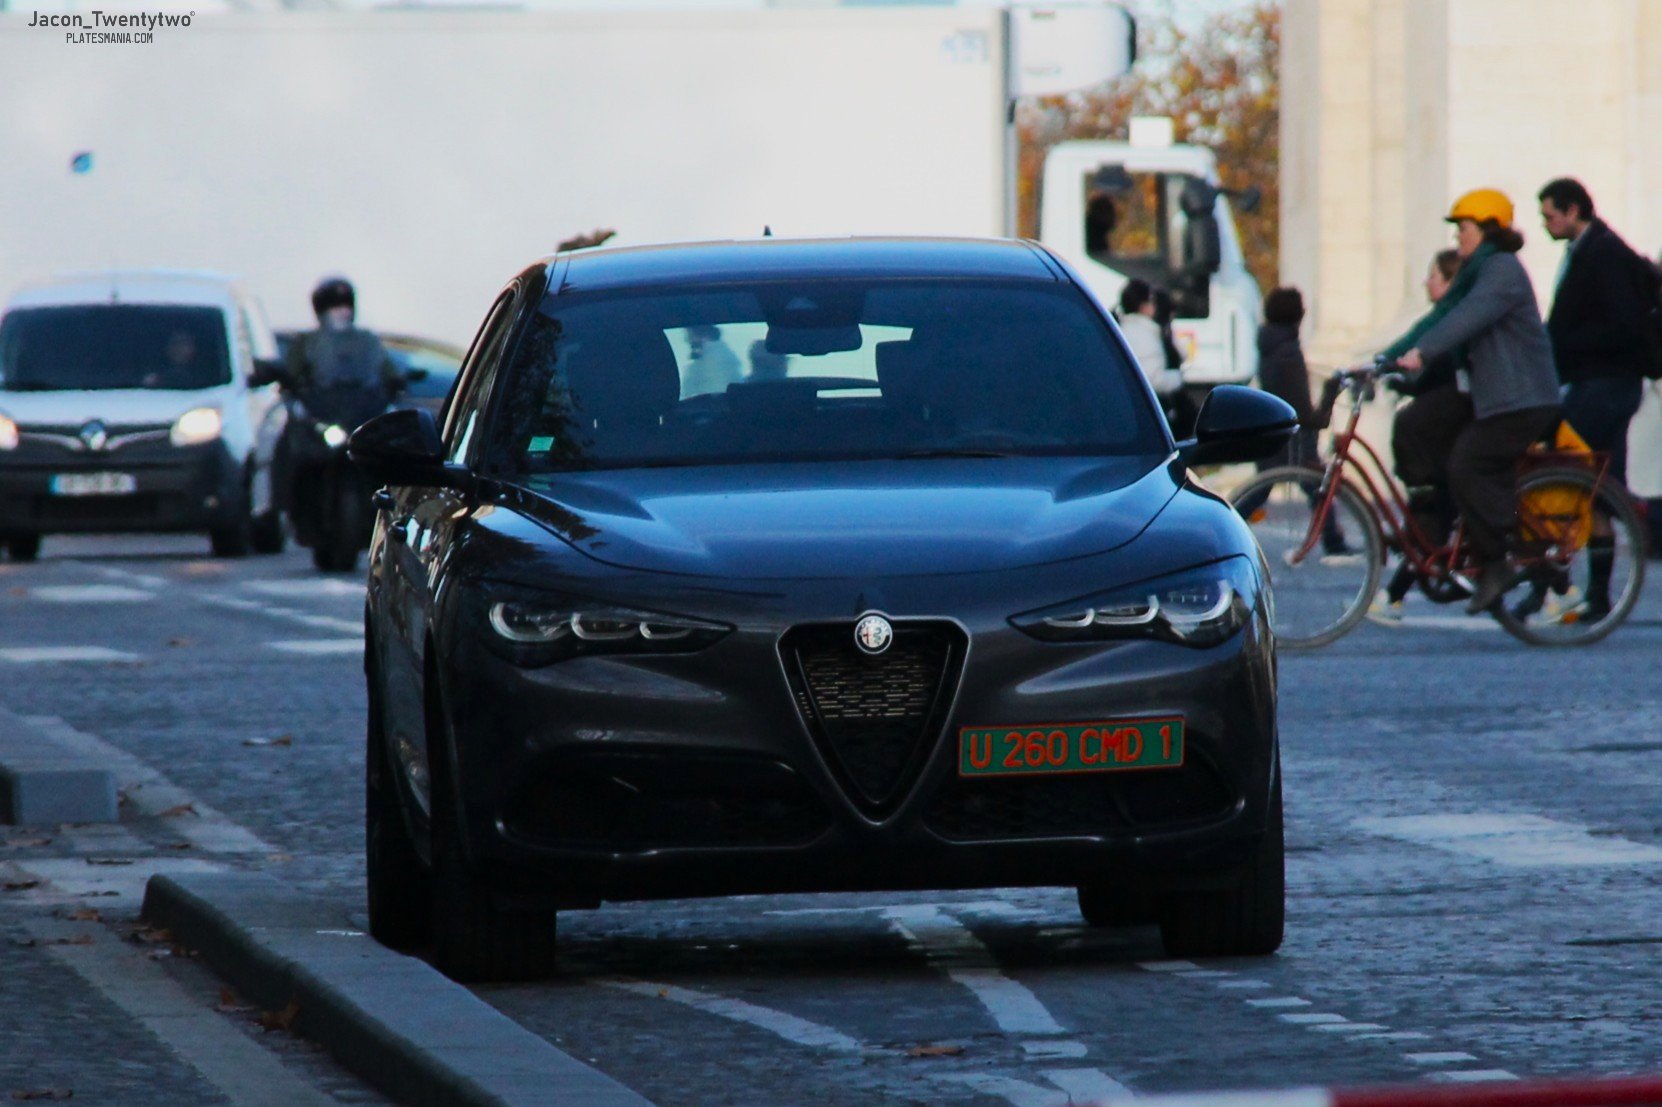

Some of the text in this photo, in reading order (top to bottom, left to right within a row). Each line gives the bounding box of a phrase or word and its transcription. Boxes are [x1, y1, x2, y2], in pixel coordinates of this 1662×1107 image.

[970, 725, 1170, 769] U 260 CMD 1
